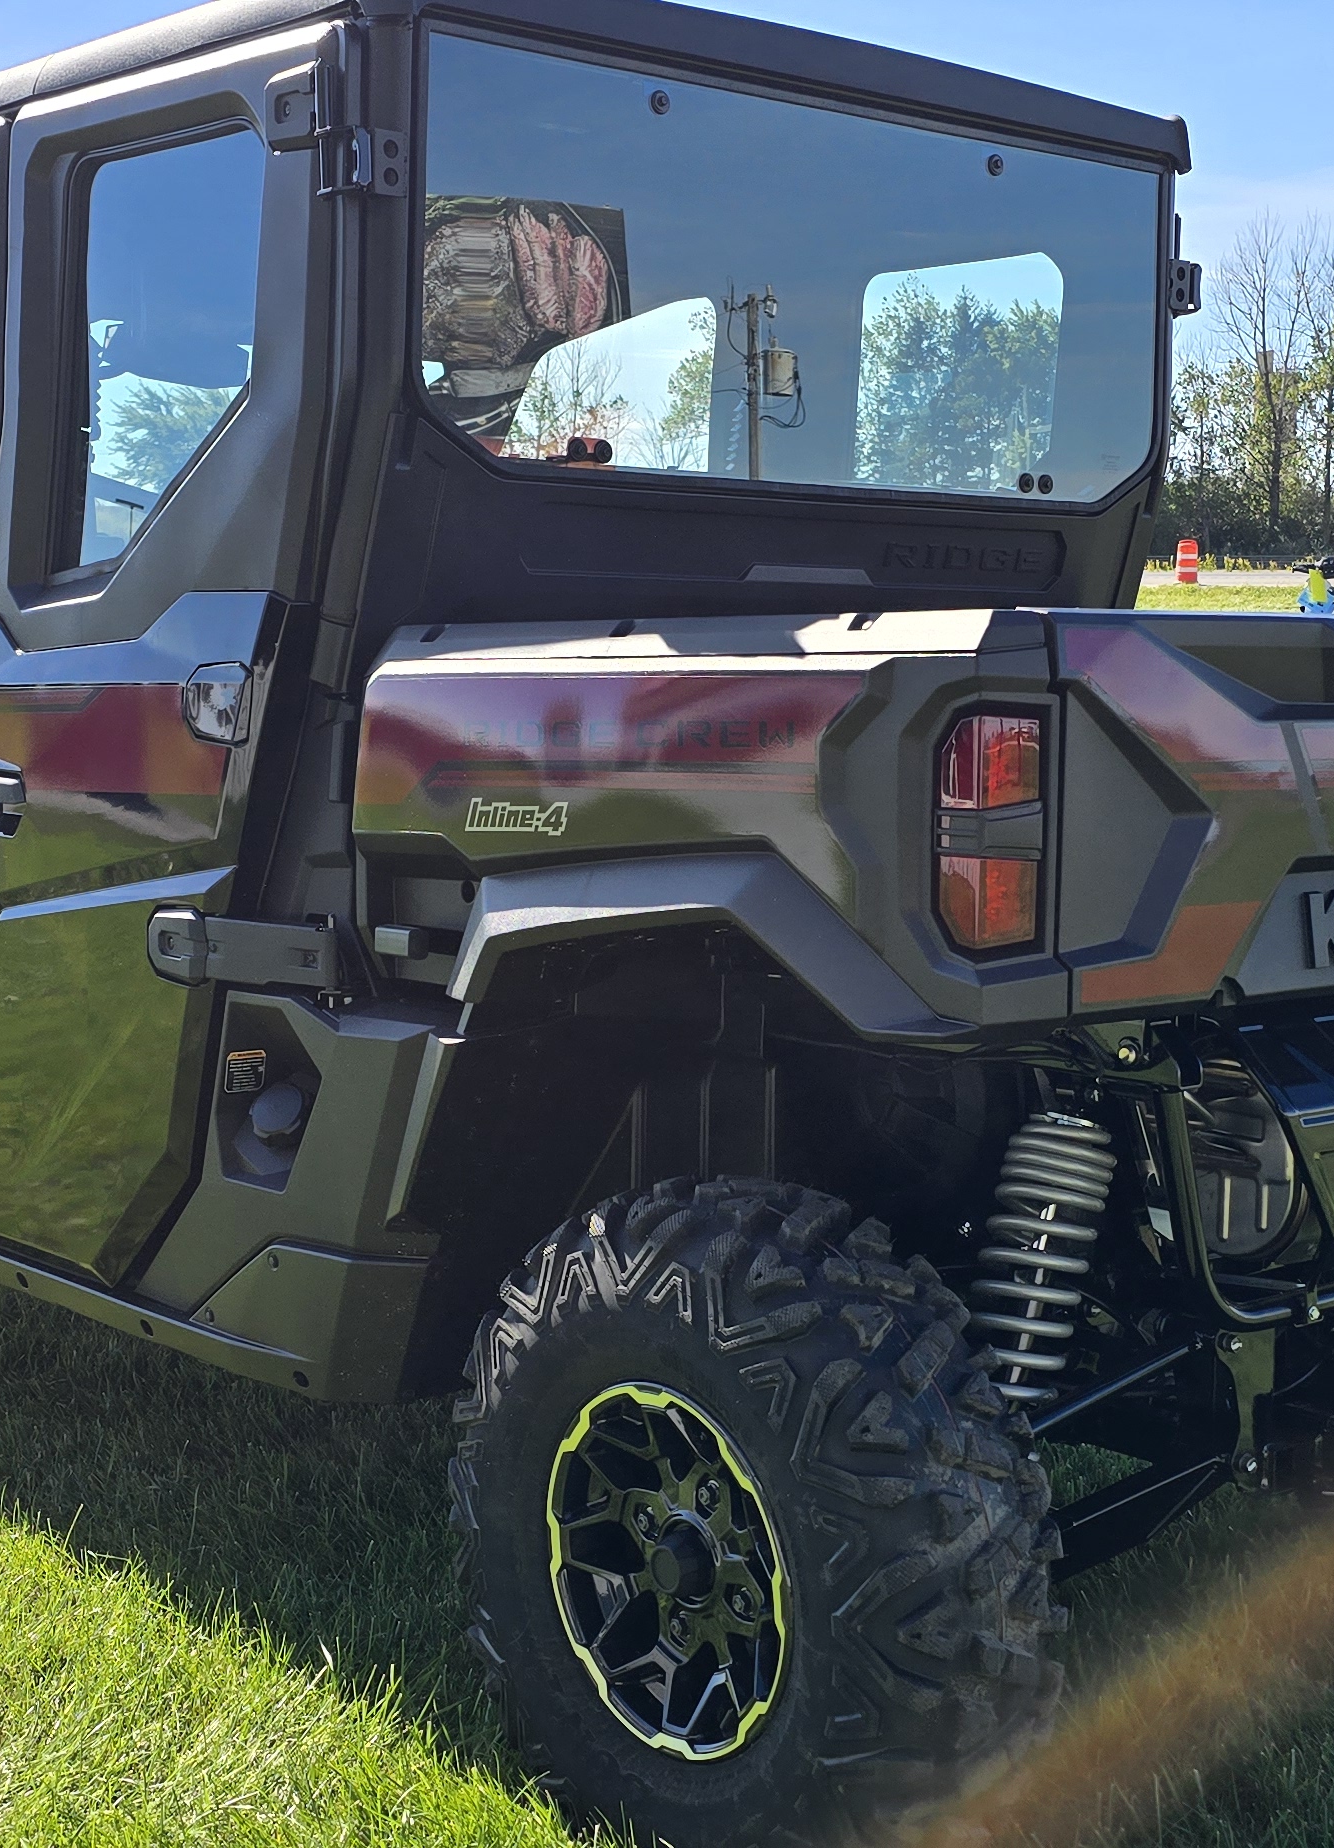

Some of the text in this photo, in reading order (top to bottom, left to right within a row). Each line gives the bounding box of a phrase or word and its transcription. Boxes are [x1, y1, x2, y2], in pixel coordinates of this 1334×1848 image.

[882, 542, 1043, 574] RIDGE
[464, 719, 796, 750] RIDGE CREW
[465, 797, 568, 836] Inline-4
